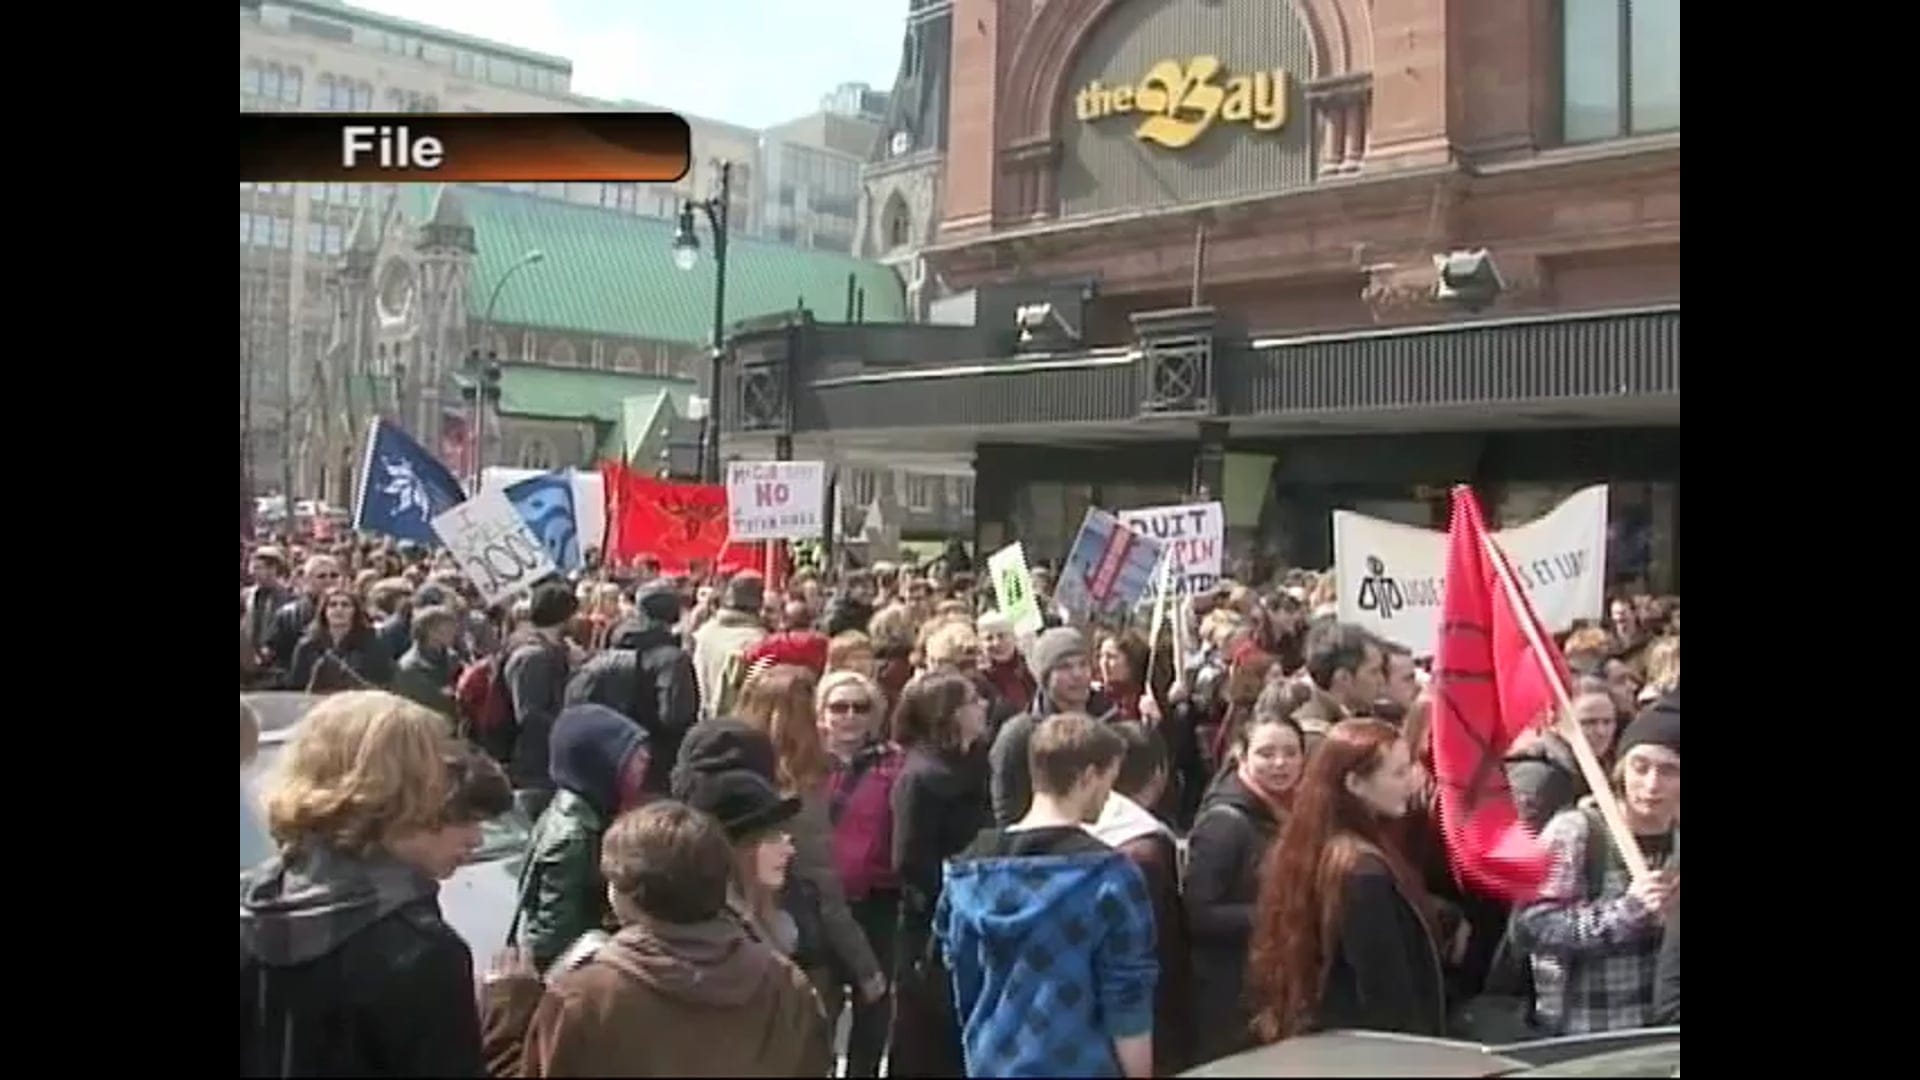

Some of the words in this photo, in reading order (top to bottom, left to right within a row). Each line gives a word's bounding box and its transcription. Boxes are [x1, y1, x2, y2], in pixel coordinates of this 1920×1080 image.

[1076, 80, 1134, 120] the
[1135, 55, 1287, 148] Bay
[755, 483, 789, 507] NO
